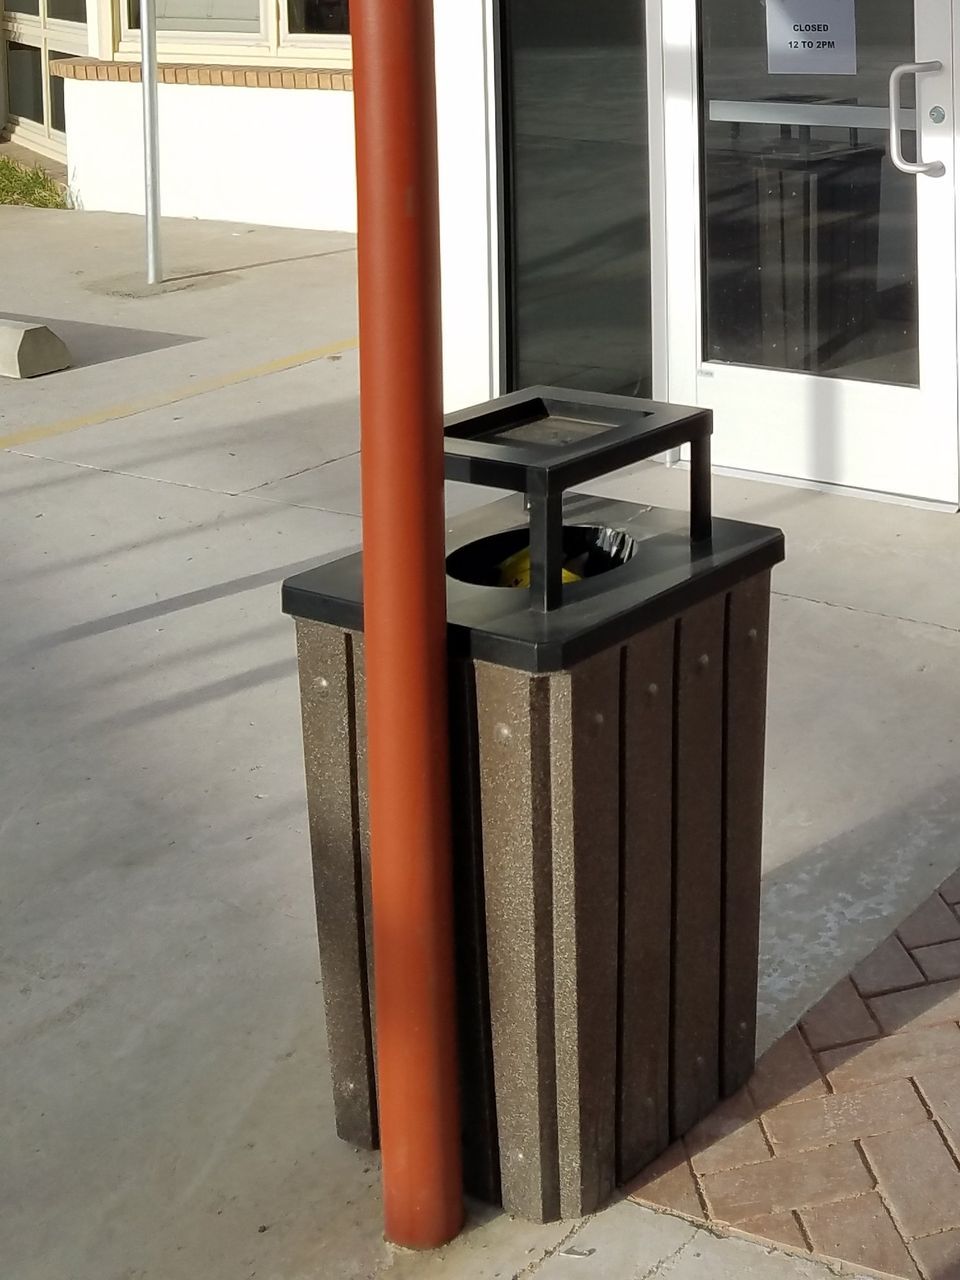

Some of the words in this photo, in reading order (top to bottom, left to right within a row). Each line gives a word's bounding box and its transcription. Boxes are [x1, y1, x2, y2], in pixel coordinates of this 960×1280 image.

[792, 24, 829, 32] CLOSED
[788, 40, 799, 49] 12
[801, 40, 814, 49] TO
[816, 40, 836, 49] 2PM
